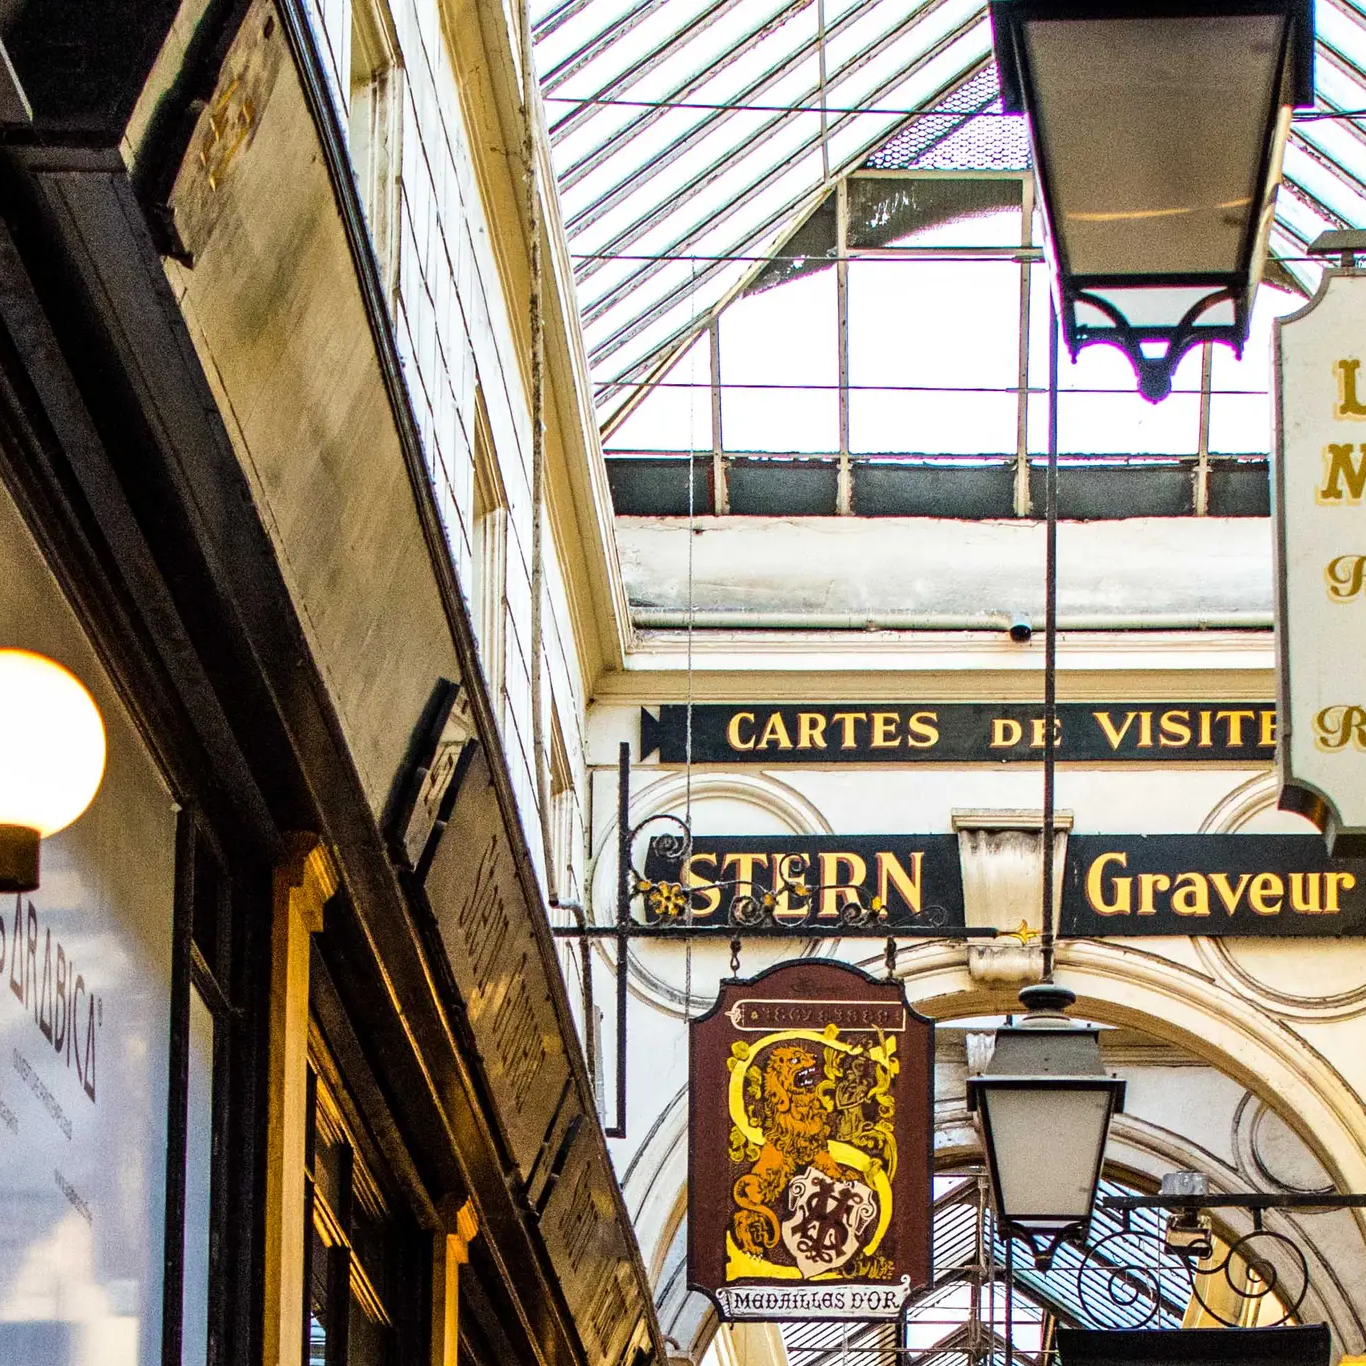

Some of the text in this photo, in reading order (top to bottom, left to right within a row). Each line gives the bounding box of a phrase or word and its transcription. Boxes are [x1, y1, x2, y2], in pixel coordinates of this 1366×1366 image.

[727, 711, 939, 751] CARTES
[993, 718, 1063, 750] DE
[679, 850, 1357, 917] STERN Graveur
